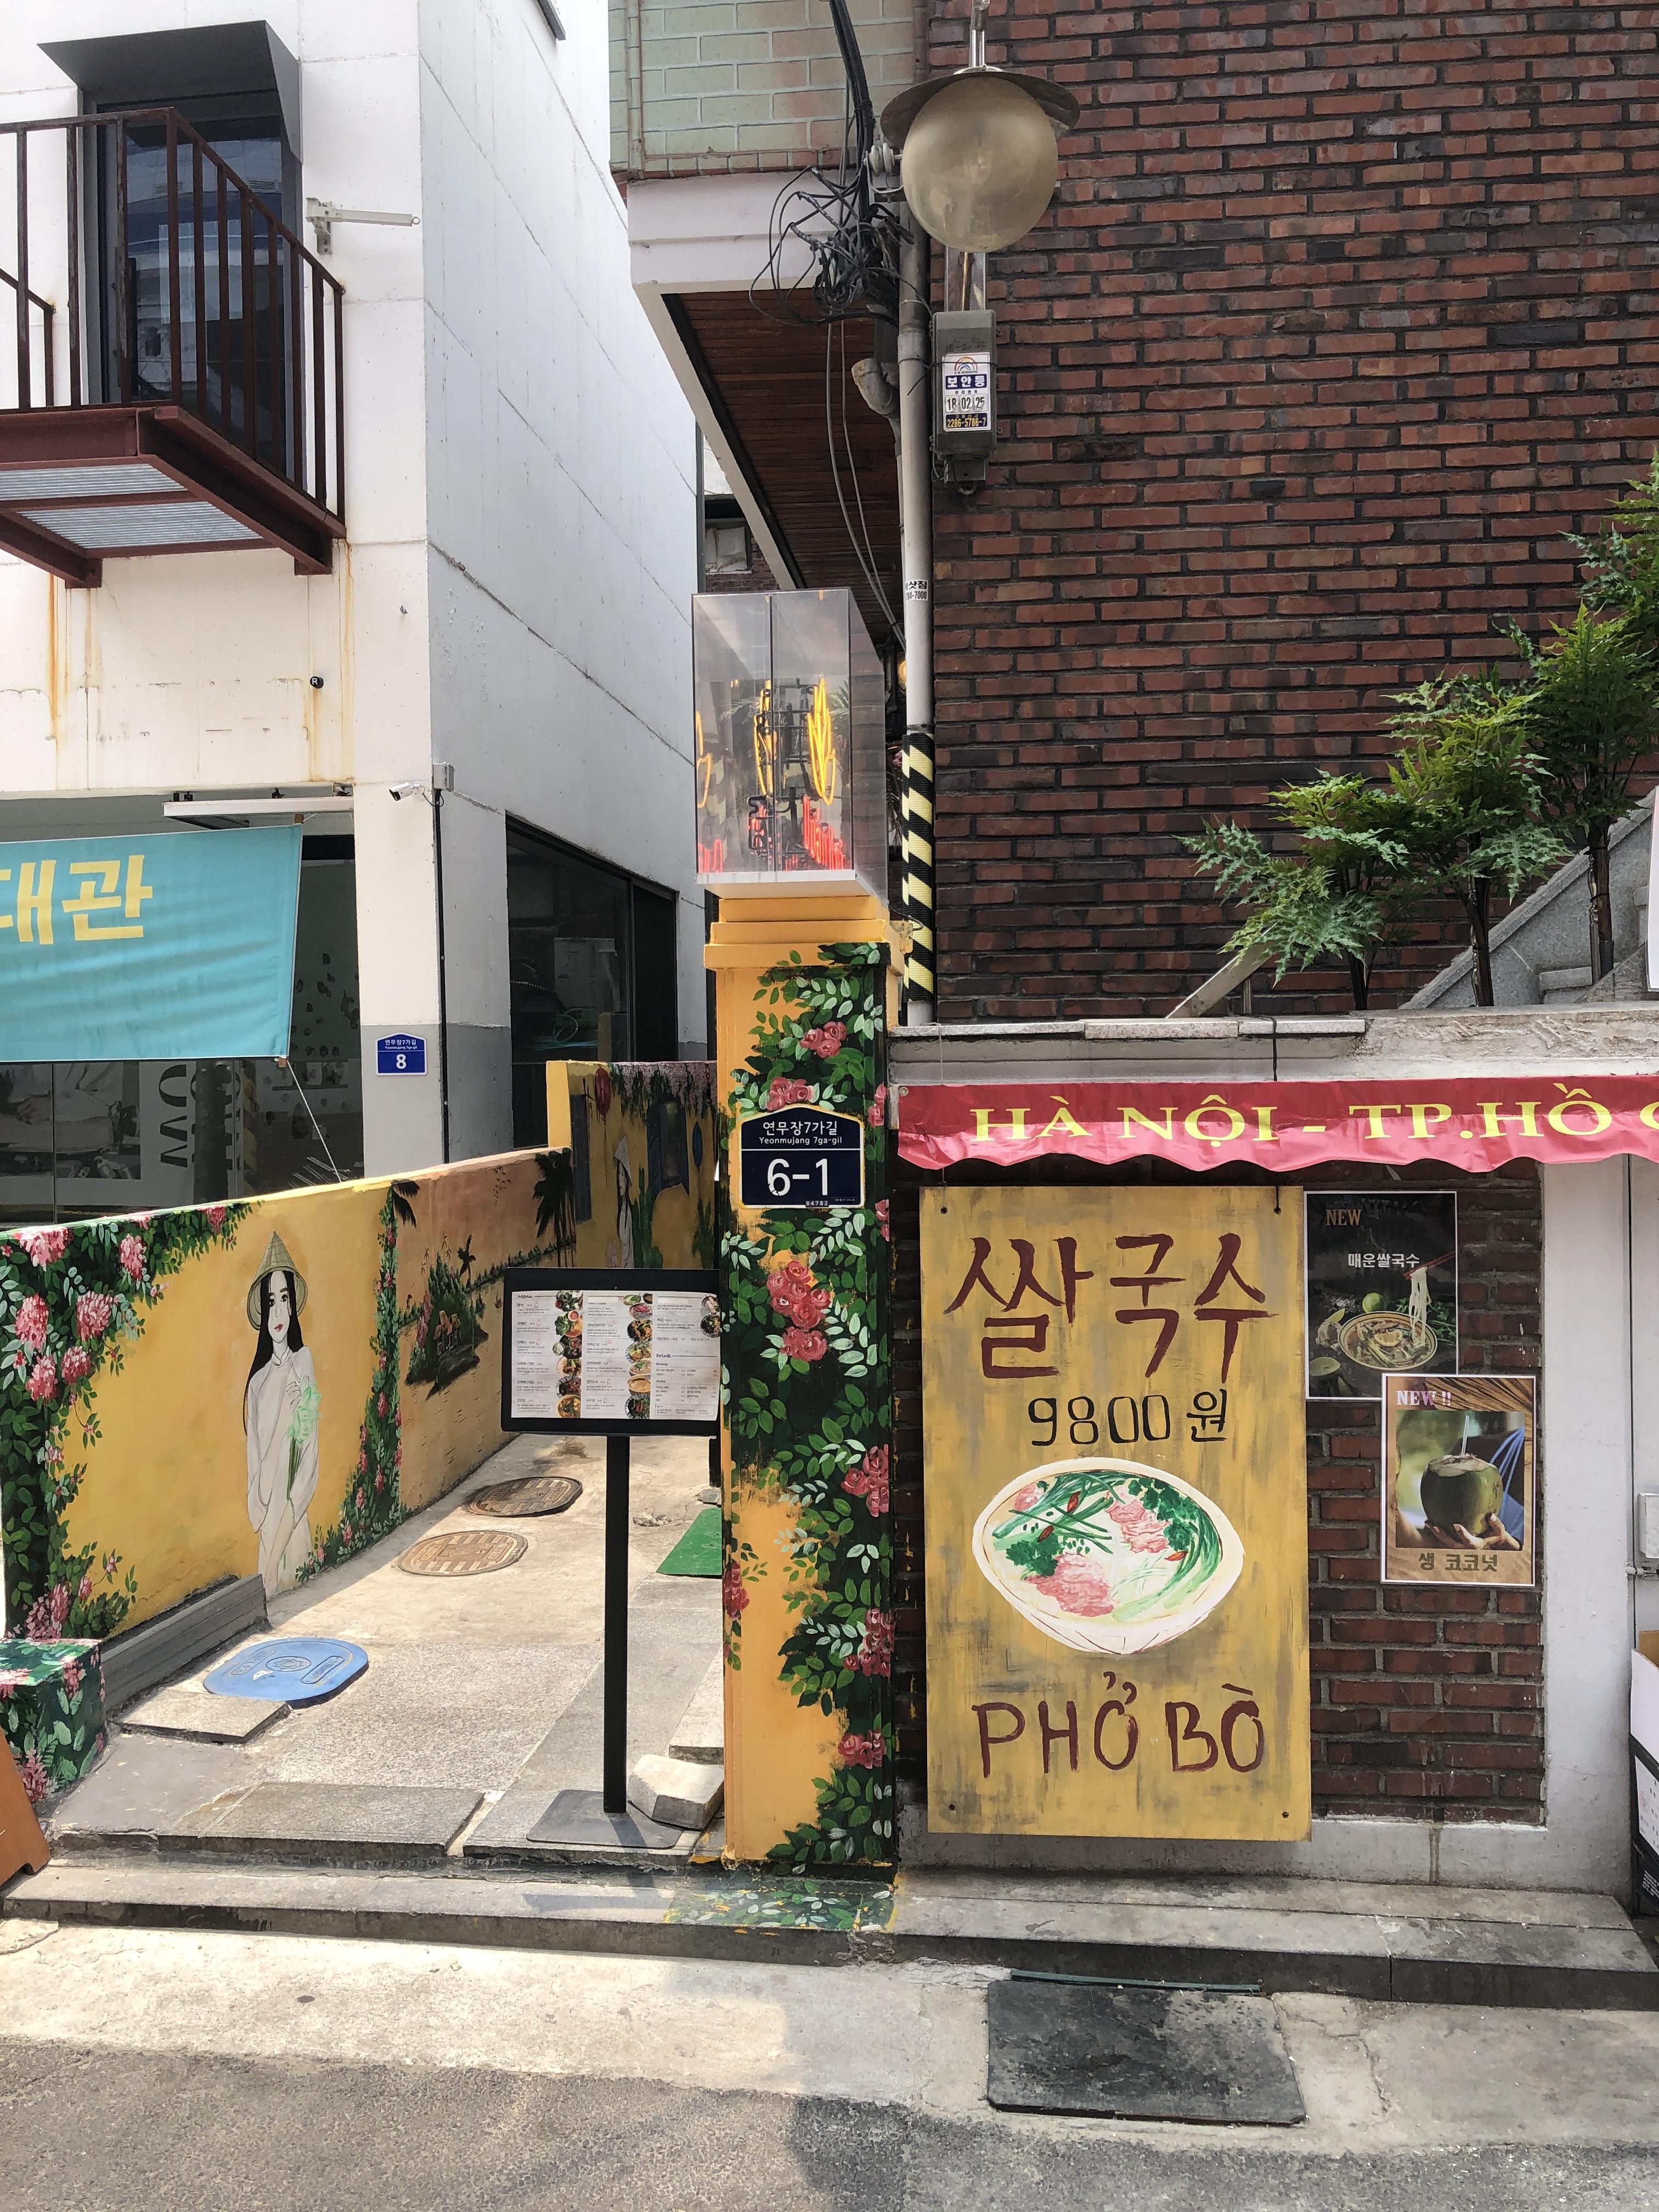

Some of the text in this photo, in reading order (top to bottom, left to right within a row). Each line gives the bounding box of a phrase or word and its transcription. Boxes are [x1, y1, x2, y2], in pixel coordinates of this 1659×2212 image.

[947, 375, 985, 387] 보안등
[947, 398, 957, 410] 18
[961, 397, 972, 410] 02
[0, 855, 153, 945] 대관
[396, 1054, 407, 1069] 8
[970, 1095, 1094, 1142] HÀ
[763, 1121, 838, 1136] 연무장7가길
[759, 1137, 843, 1146] Yeonmujang 7ga-gil
[768, 1158, 828, 1197] 6-1
[1325, 1209, 1362, 1226] NEW
[1347, 1253, 1420, 1269] 매운쌀국수
[943, 1233, 1280, 1382] 쌀국수
[1396, 1390, 1435, 1406] NEW
[1418, 1552, 1498, 1573] 생 코코넛
[1164, 1682, 1265, 1774] BÒ
